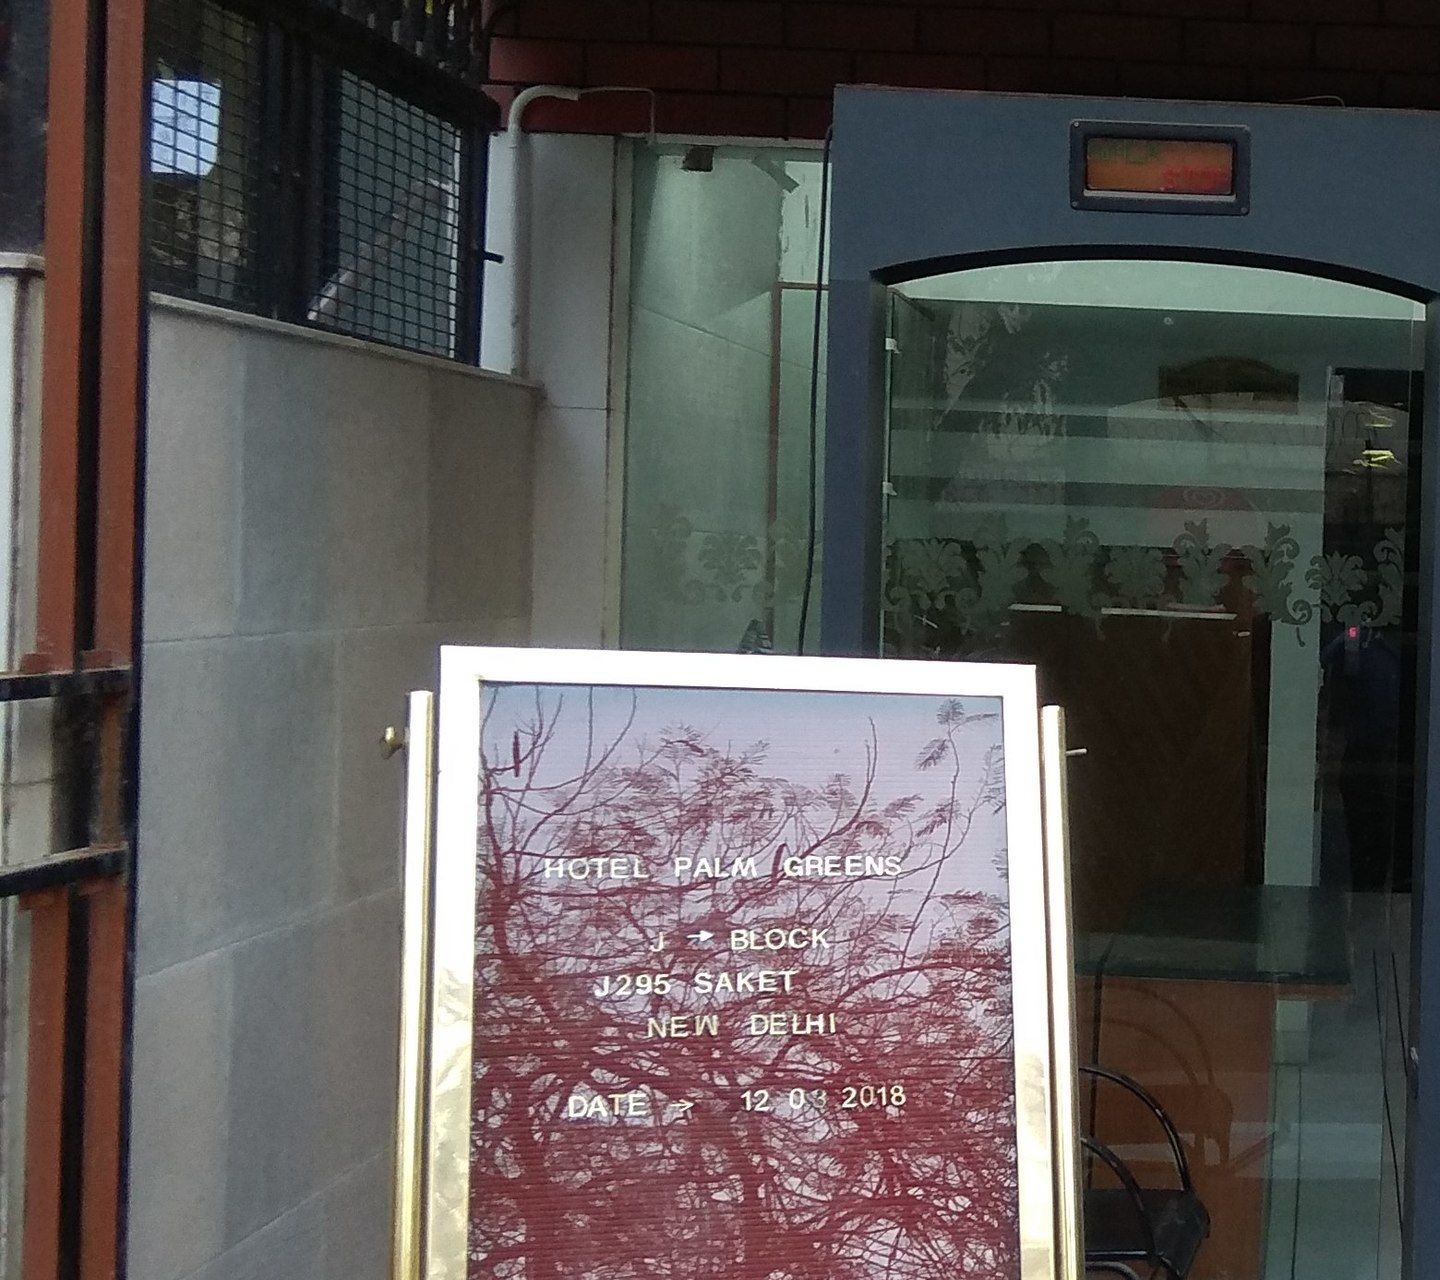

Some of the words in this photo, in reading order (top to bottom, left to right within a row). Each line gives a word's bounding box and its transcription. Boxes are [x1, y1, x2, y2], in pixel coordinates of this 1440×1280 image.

[544, 856, 649, 880] HOTEL
[674, 856, 758, 878] PALM
[783, 855, 902, 877] GREENS
[650, 930, 666, 953] J
[730, 928, 831, 951] BLOCK
[594, 973, 672, 998] J295
[693, 969, 801, 994] SAKET
[648, 1014, 719, 1039] NEW
[750, 1013, 837, 1036] DELHI
[567, 1093, 648, 1118] DATE
[739, 1088, 770, 1112] 12
[841, 1085, 907, 1109] 2018
